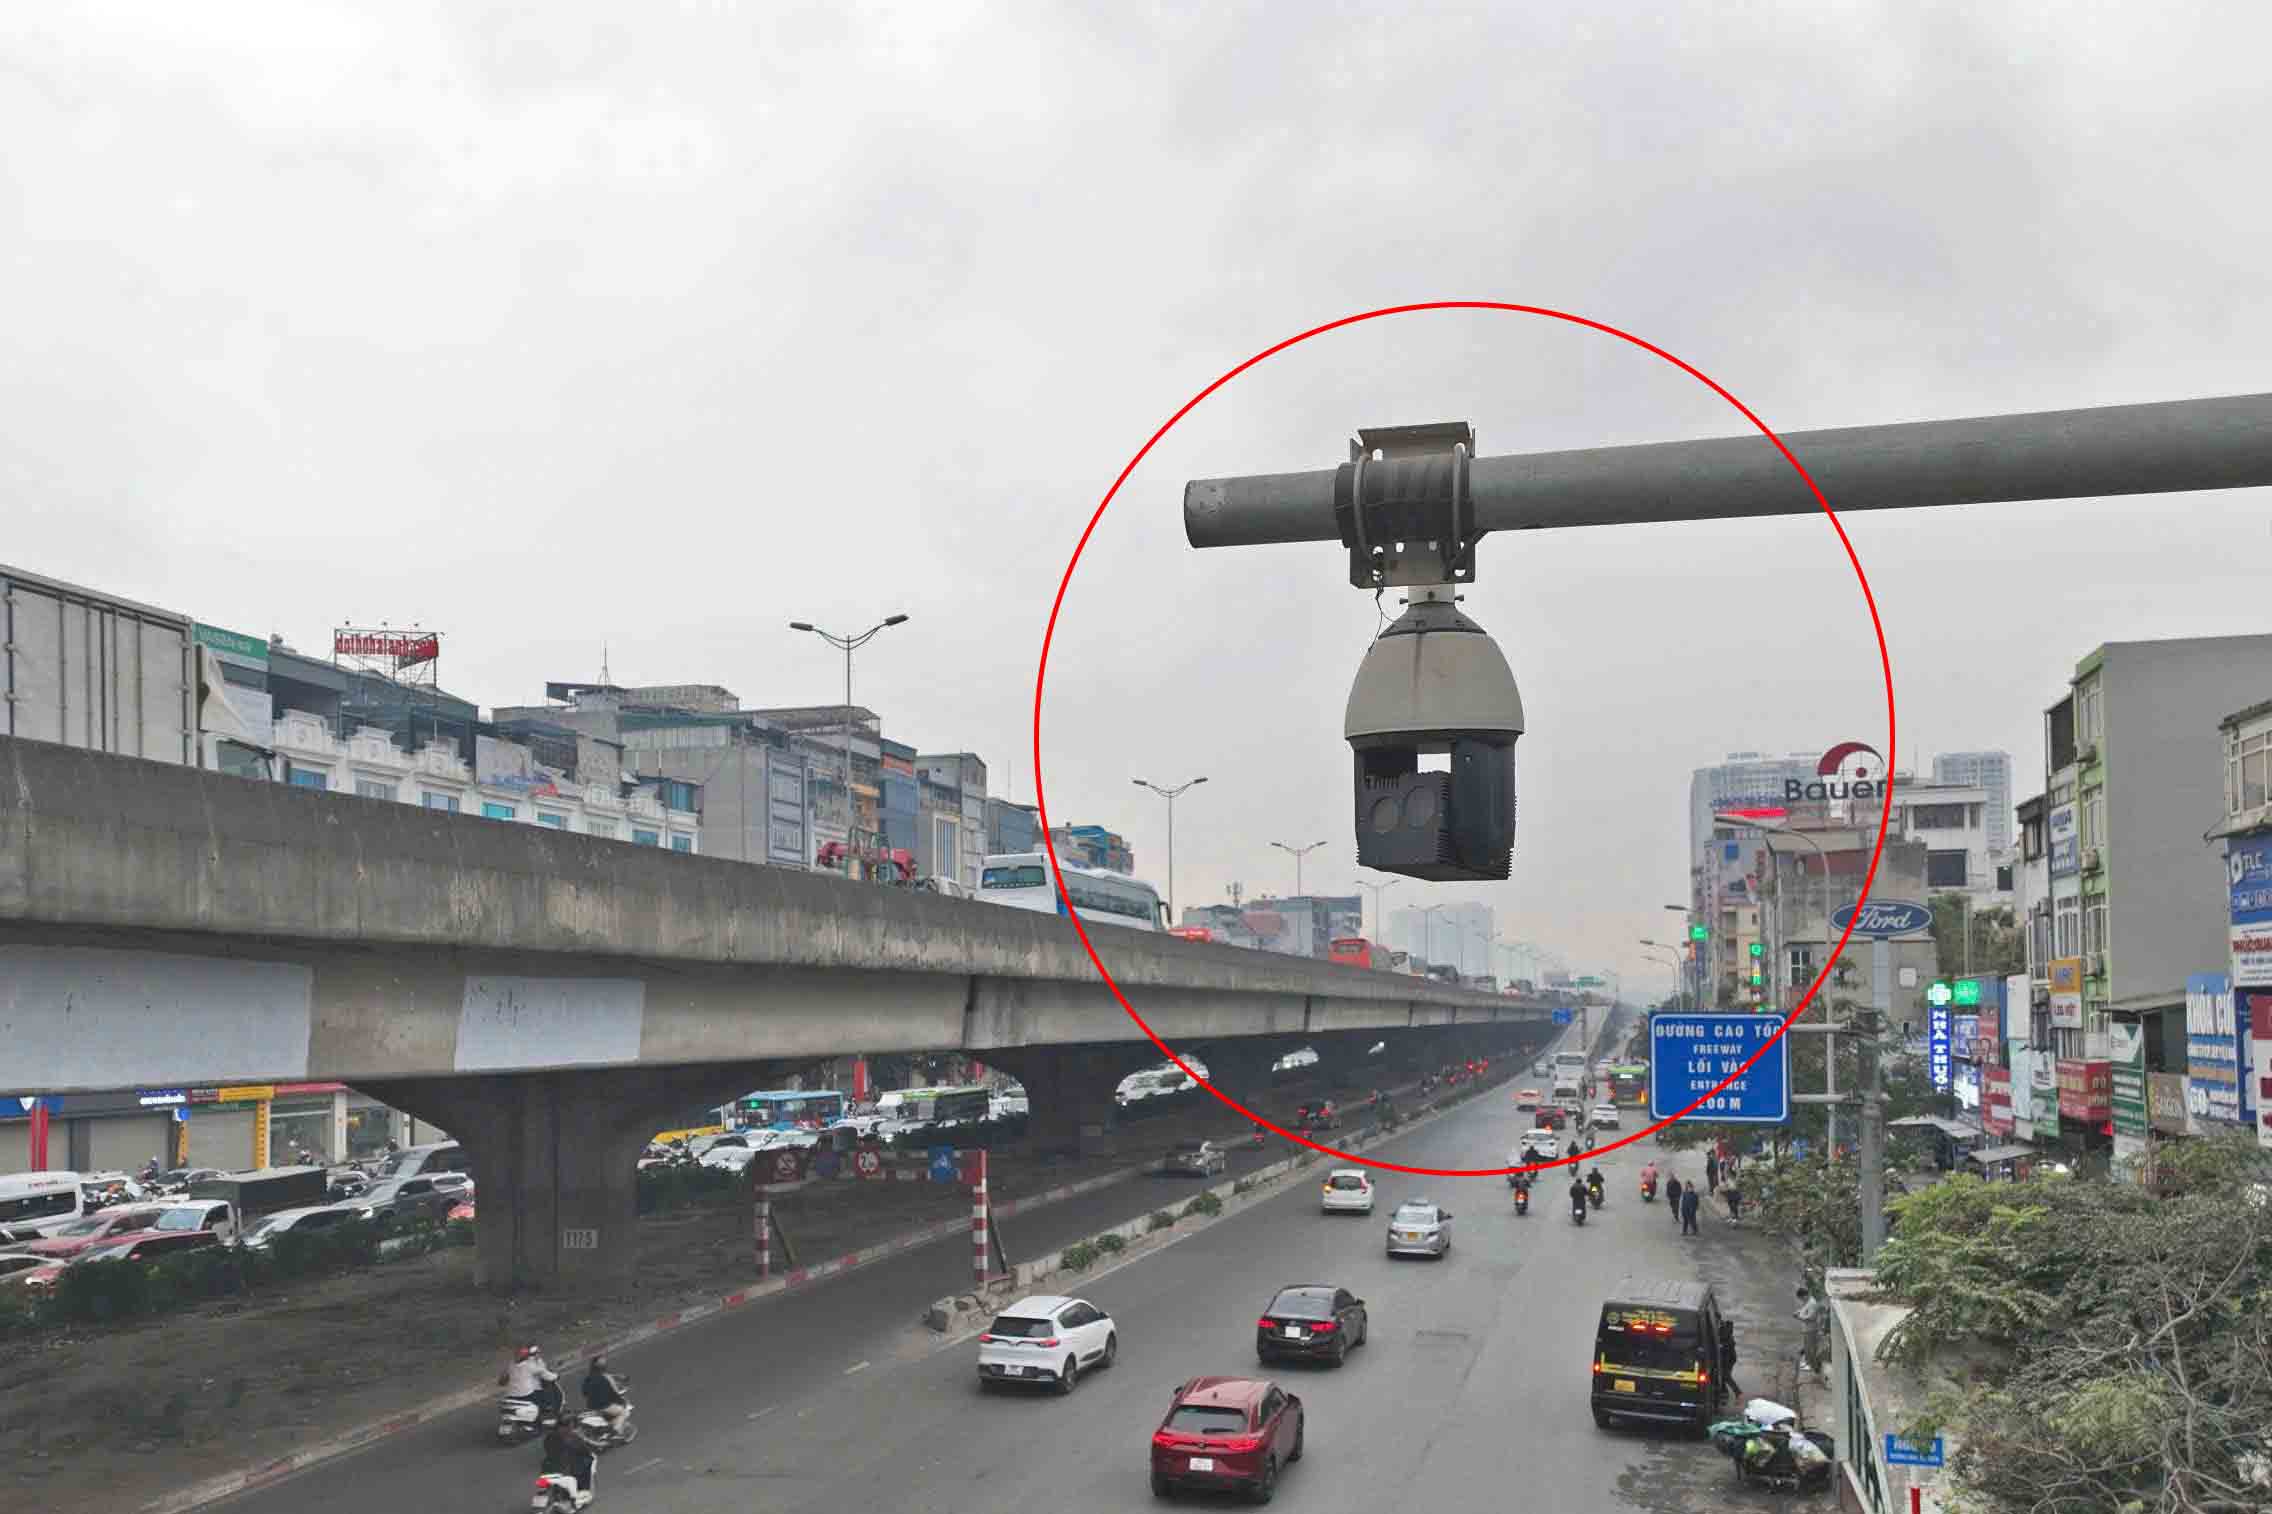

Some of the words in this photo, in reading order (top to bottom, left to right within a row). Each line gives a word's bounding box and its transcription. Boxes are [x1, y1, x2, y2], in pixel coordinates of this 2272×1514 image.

[1785, 779, 1888, 801] Bauer
[1853, 905, 1912, 930] Ford
[1714, 1024, 1744, 1037] CAO
[1693, 1044, 1743, 1055] FREEWAY
[1729, 1097, 1741, 1110] M
